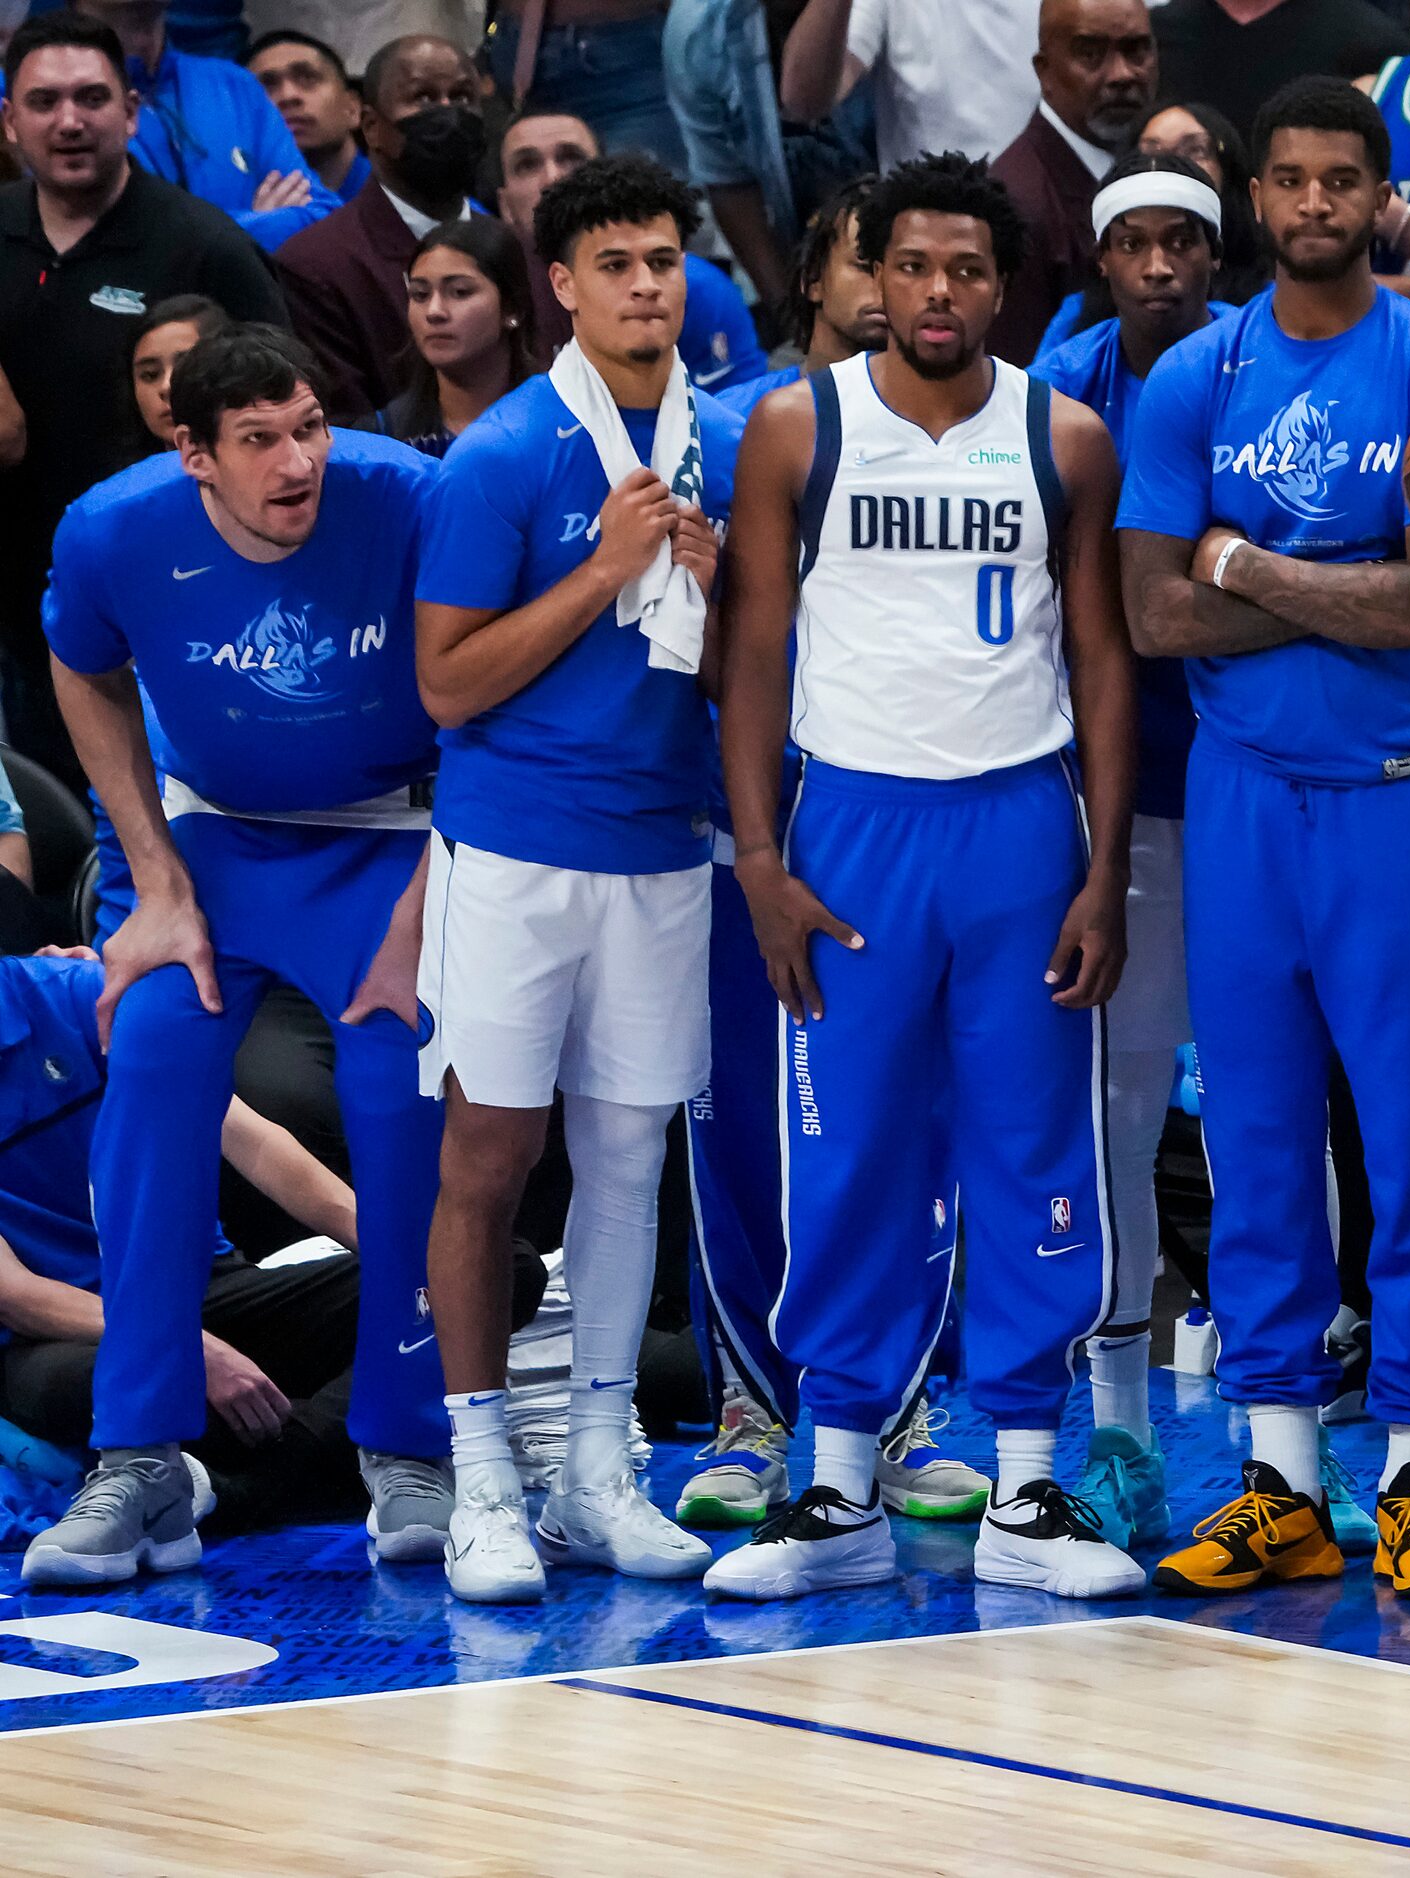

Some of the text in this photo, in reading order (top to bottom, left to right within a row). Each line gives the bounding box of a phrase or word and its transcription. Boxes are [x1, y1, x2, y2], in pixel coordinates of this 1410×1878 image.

[968, 447, 1021, 465] chime
[1213, 433, 1401, 482] DALLAS IN
[849, 494, 1023, 553] DALLAS
[976, 562, 1016, 646] 0
[186, 614, 387, 673] DALLAS IN
[794, 1030, 822, 1136] MAVERICKS
